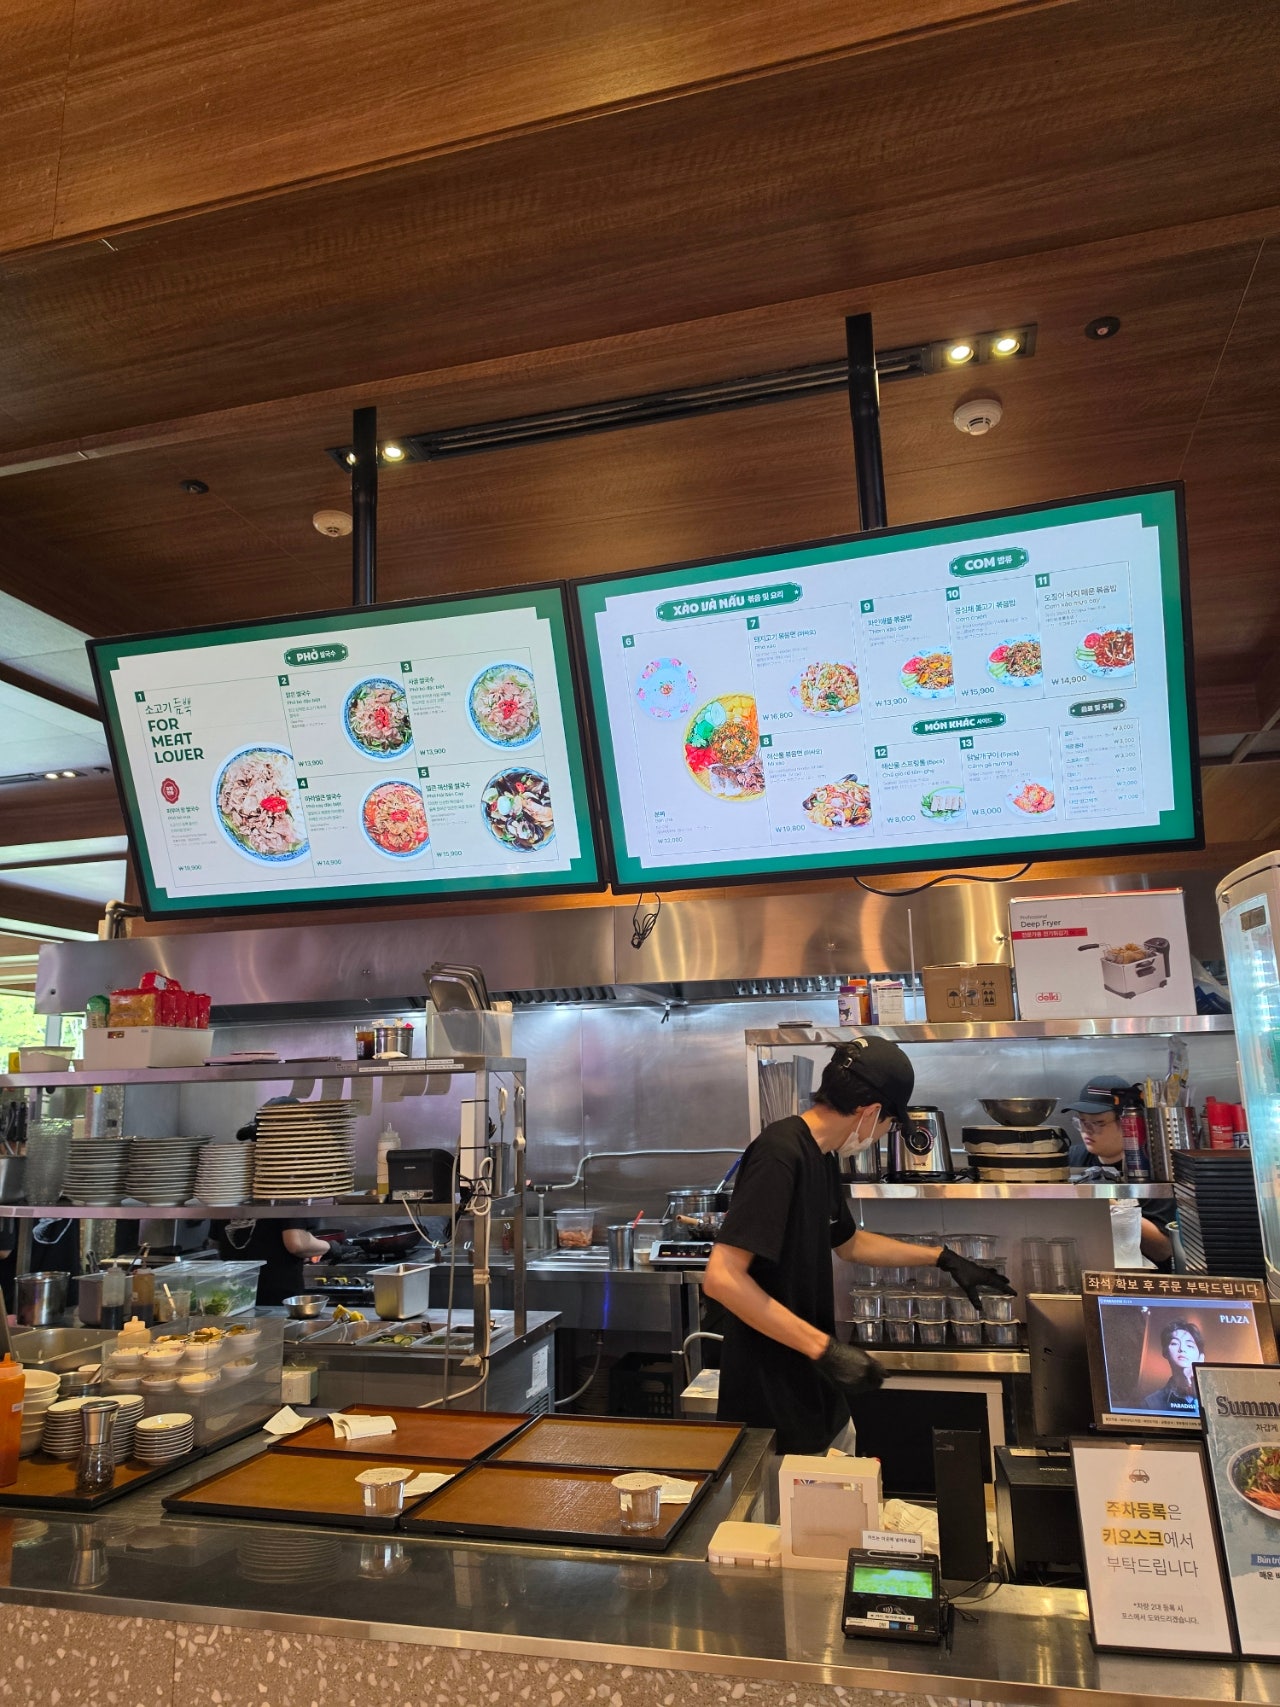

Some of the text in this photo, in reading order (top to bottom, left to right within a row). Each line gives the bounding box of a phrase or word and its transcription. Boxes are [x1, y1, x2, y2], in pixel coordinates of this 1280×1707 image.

[1037, 576, 1048, 586] 11
[770, 590, 784, 600] 요리
[947, 590, 959, 599] 10
[1081, 587, 1095, 596] 매운
[1096, 584, 1117, 593] 볶음밥
[864, 602, 871, 610] 9
[975, 602, 995, 612] 불고기
[996, 599, 1016, 608] 볶음밥
[750, 619, 756, 628] 7
[626, 638, 632, 646] 6
[404, 663, 410, 671] 3
[145, 702, 172, 715] 소고기
[148, 718, 180, 732] FOR
[924, 721, 948, 732] MÓN
[949, 718, 976, 728] KHÁC
[152, 732, 192, 748] MEAT
[961, 739, 972, 748] 13
[154, 748, 204, 764] LOVER
[876, 749, 886, 757] 12
[1020, 919, 1062, 928] Deep Fryer
[1088, 1277, 1259, 1296] 좌석 확보 후 주문 부탁드립니다
[1219, 1314, 1250, 1325] PLAZA
[1256, 1424, 1279, 1432] 차갑게
[1106, 1501, 1182, 1520] 주차등록은
[1102, 1528, 1194, 1549] 키오스크에서
[1106, 1556, 1199, 1578] 부탁드립니다
[1259, 1572, 1274, 1580] 매운
[1150, 1603, 1162, 1611] 2대
[1163, 1604, 1176, 1612] 등록
[1177, 1604, 1184, 1613] 시
[1122, 1612, 1146, 1622] 포스에서
